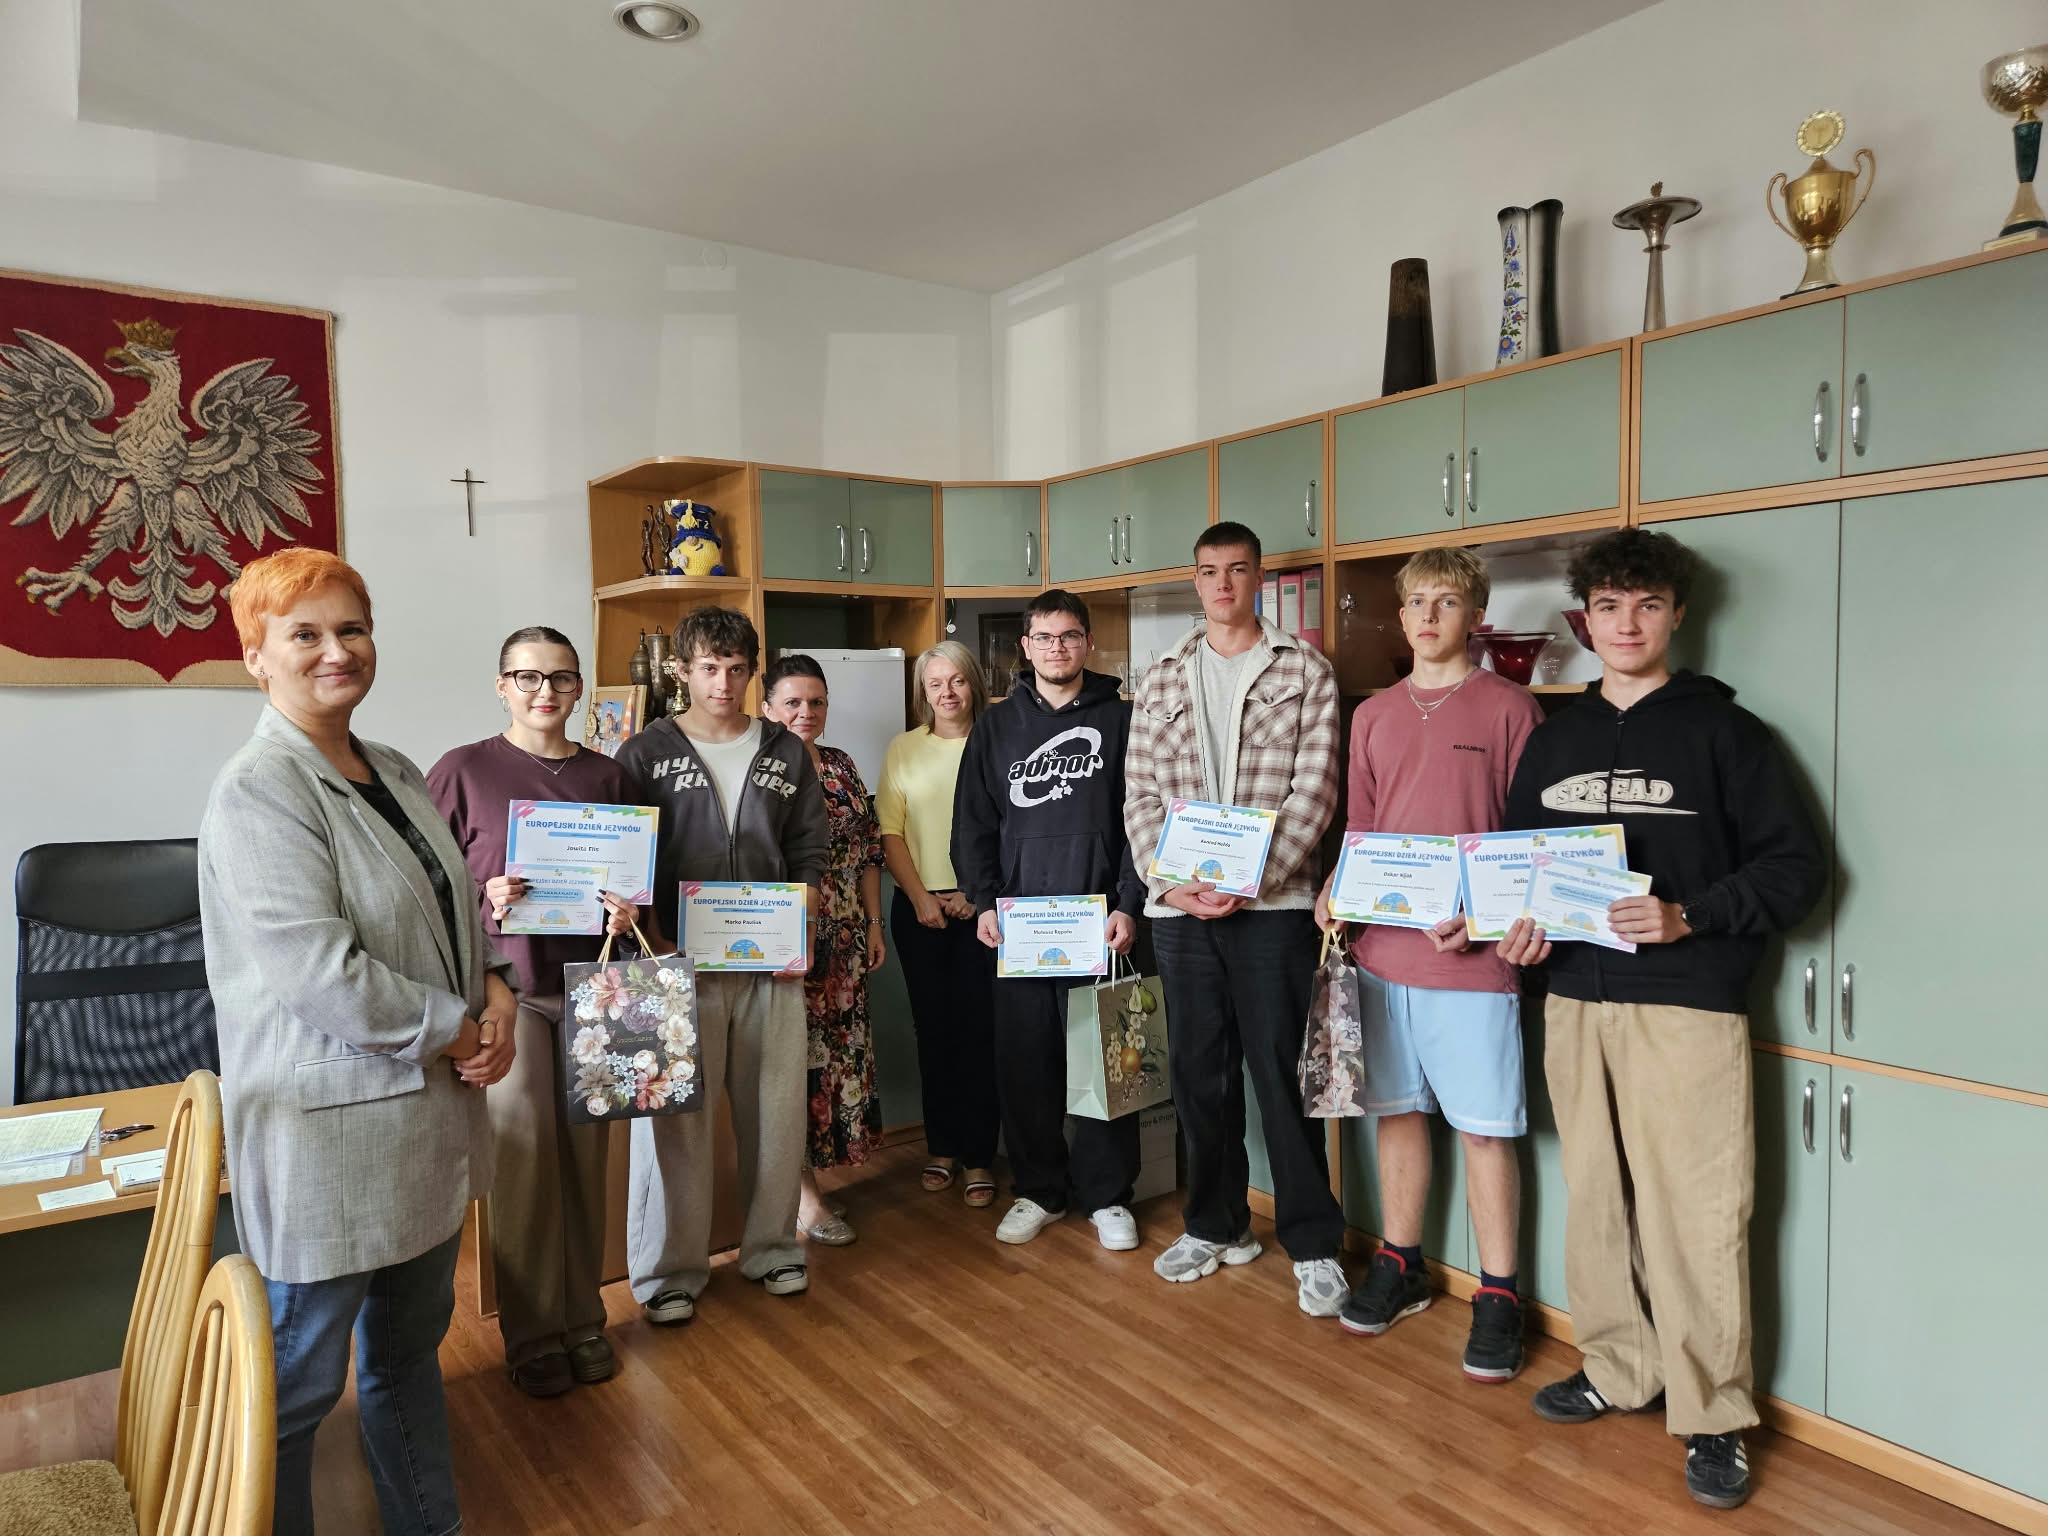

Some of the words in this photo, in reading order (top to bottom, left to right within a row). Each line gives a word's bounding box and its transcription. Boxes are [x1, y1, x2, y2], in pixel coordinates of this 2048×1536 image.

[1557, 778, 1674, 804] SPREAD
[525, 820, 576, 830] EUROPEJSKI
[578, 821, 602, 831] DZIEŃ
[604, 824, 641, 833] JĘZYKÓW
[1354, 848, 1395, 858] EUROPEJSKI
[1397, 851, 1416, 860] DZIEŃ
[1474, 853, 1528, 862] EUROPEJSKI
